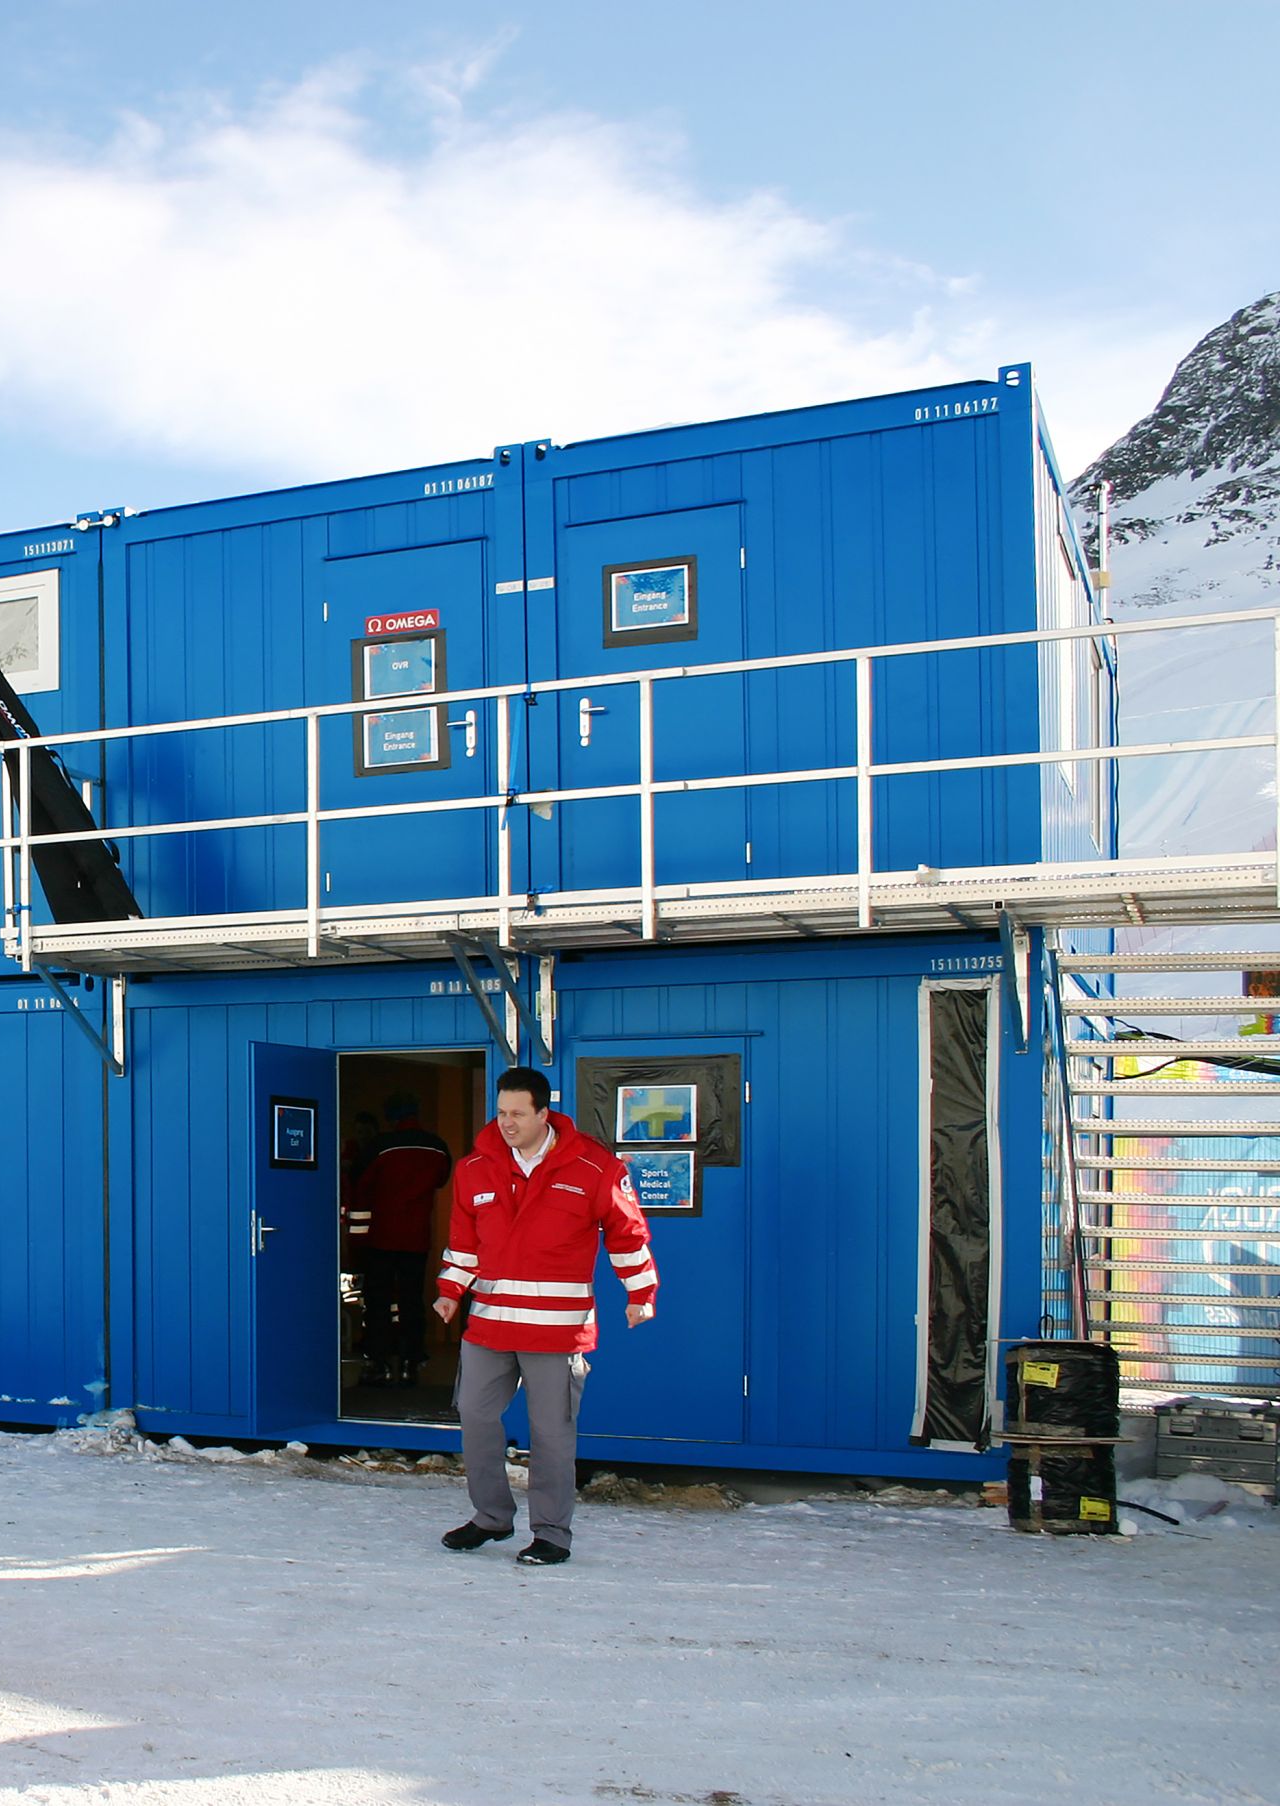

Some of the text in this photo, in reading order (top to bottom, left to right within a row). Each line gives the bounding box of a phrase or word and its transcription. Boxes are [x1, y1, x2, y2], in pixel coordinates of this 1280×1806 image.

[914, 396, 998, 421] 01 11 06197
[424, 473, 494, 495] 01 11 06187
[23, 538, 75, 557] 151113071
[631, 602, 669, 613] Entrance
[385, 614, 436, 631] OMEGA
[930, 955, 1004, 972] 151113755
[430, 981, 443, 993] 01
[17, 998, 29, 1010] 01
[641, 1168, 669, 1179] Sports
[639, 1180, 672, 1189] Medical
[641, 1191, 669, 1200] Center
